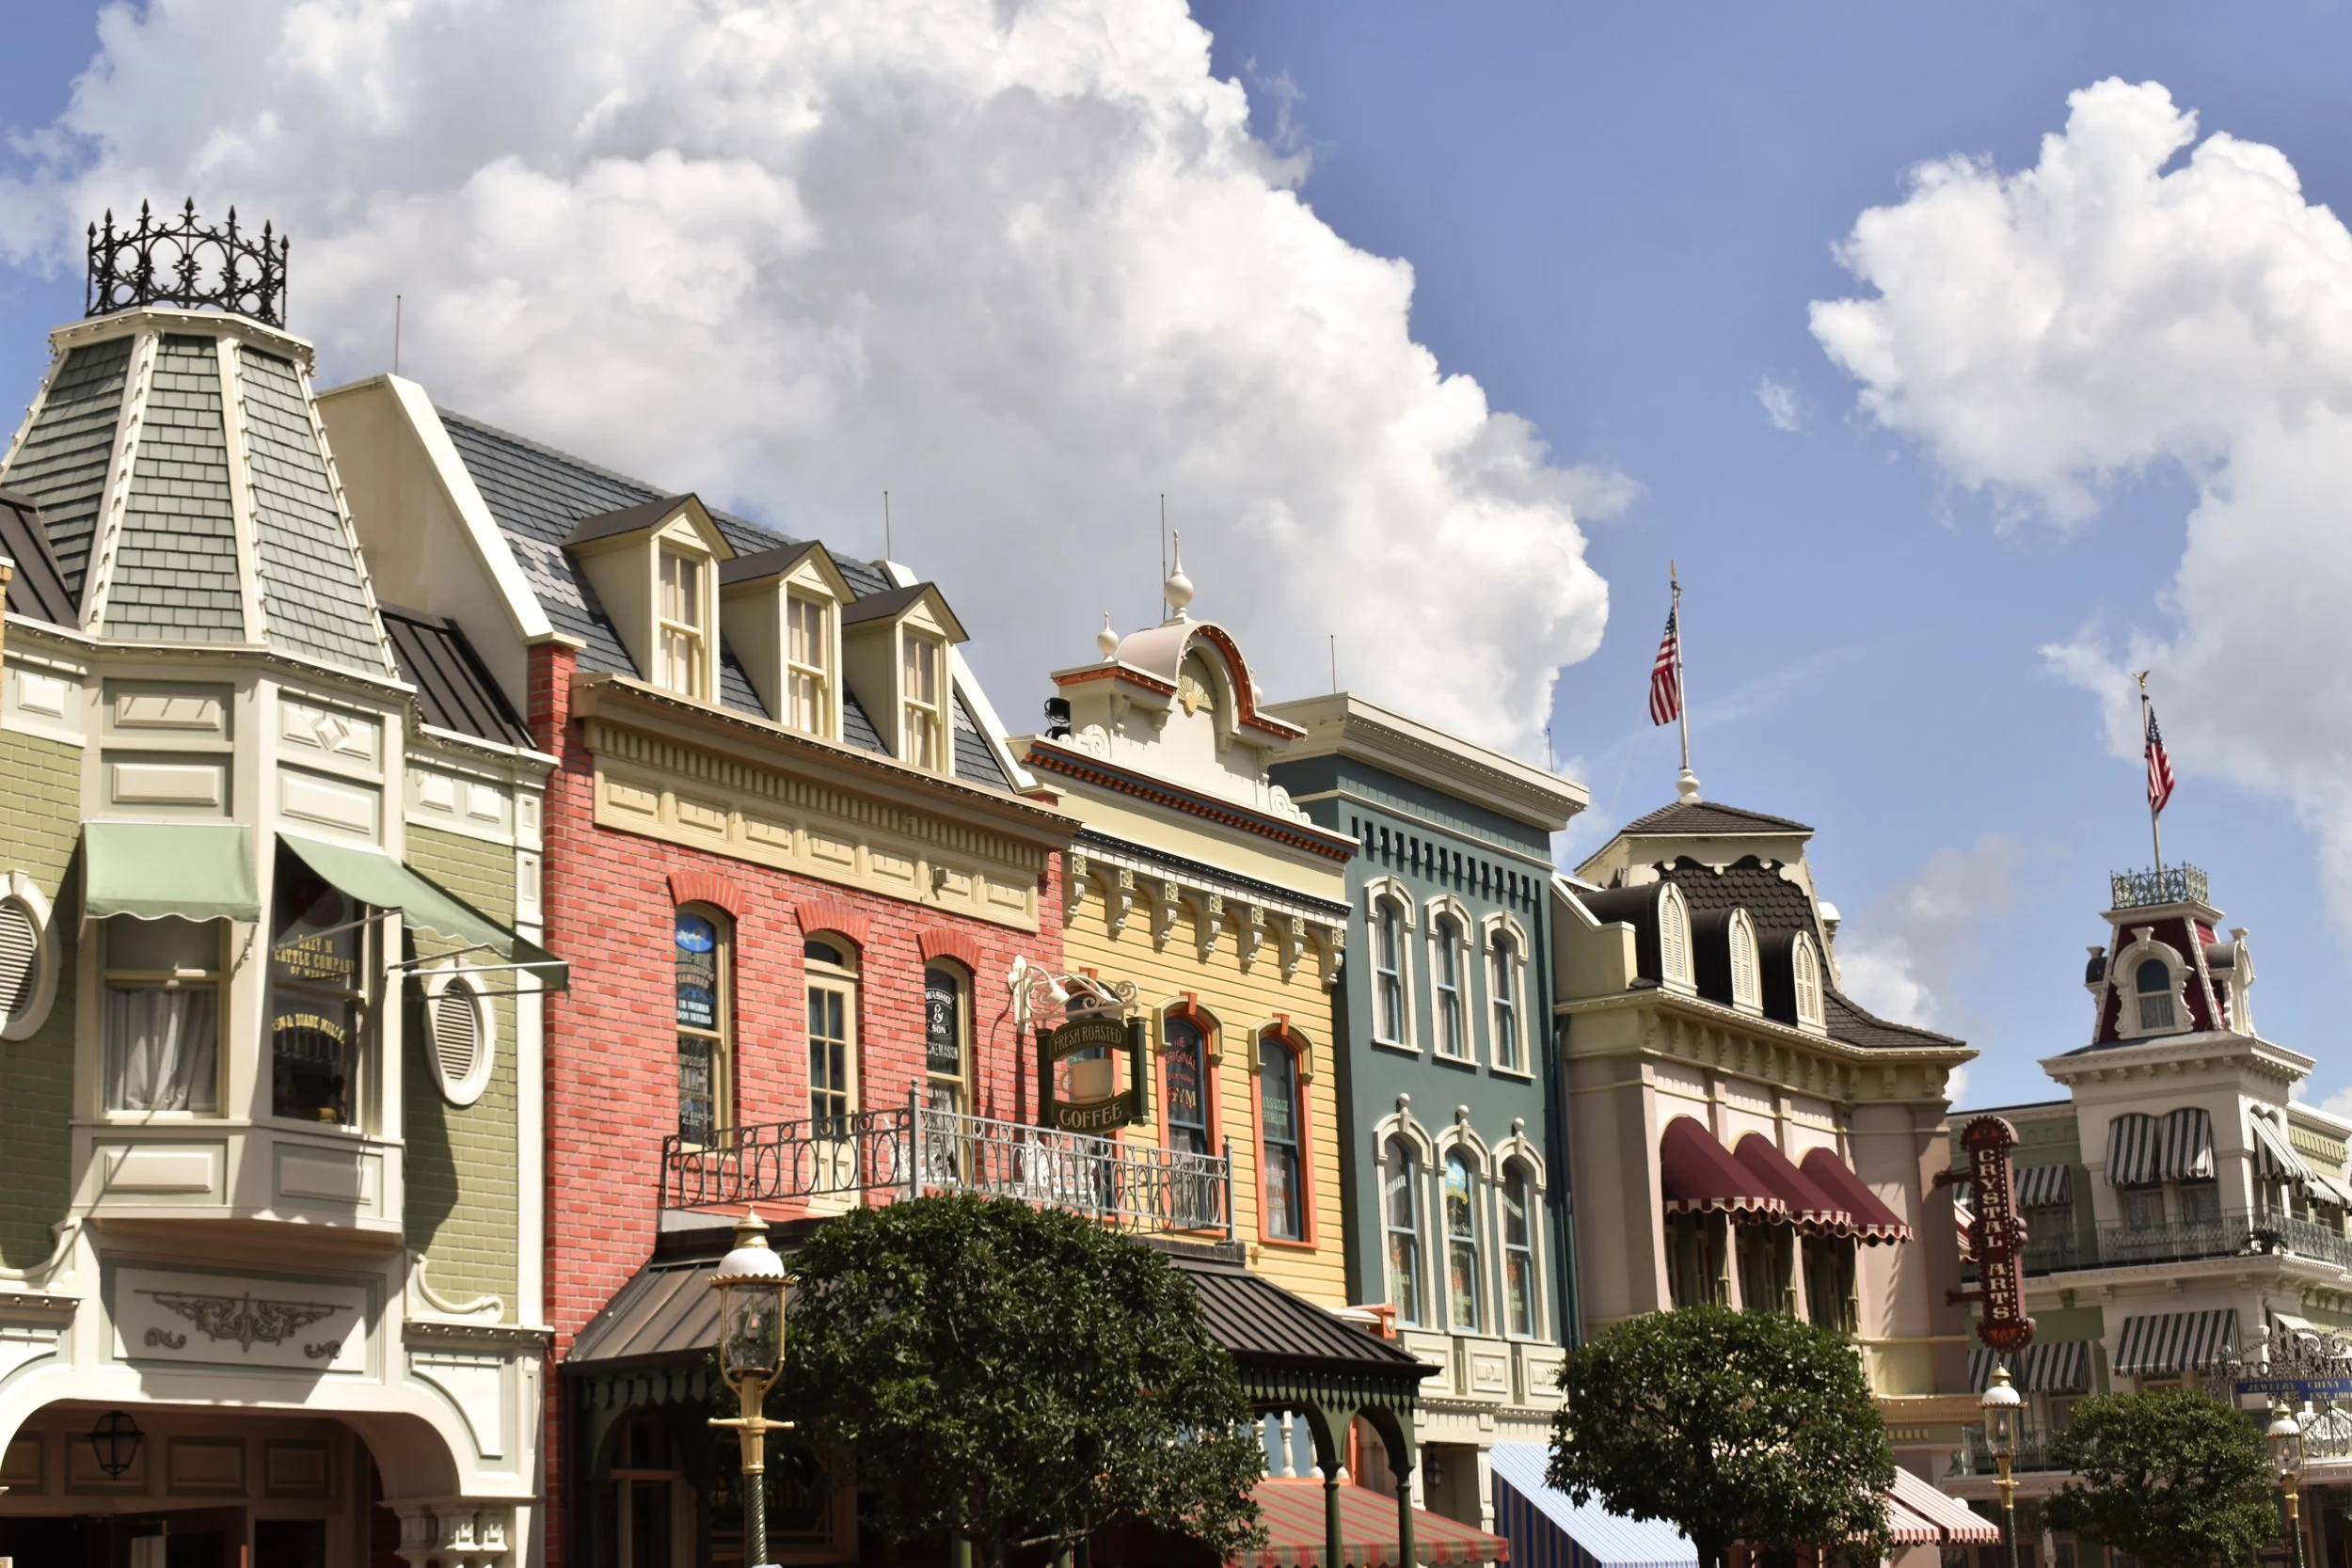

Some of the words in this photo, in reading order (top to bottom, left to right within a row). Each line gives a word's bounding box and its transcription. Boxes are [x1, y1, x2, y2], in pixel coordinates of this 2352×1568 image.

[298, 934, 322, 952] LAZY
[275, 948, 310, 967] CATTLE
[313, 953, 356, 974] COMPANY
[925, 990, 951, 1006] WASHO
[933, 1004, 944, 1023] &
[931, 1024, 946, 1034] SON
[1053, 1030, 1081, 1053] FRESH
[1082, 1025, 1122, 1045] ROASTED
[1165, 1050, 1196, 1070] ORIGINAL
[1167, 1086, 1197, 1109] GYM
[1059, 1101, 1122, 1129] COFFEE
[1979, 1148, 2003, 1248] CRYSTAL
[1989, 1263, 2010, 1321] ARTS
[2247, 1381, 2296, 1393] JEWELRY
[2306, 1380, 2341, 1390] CHINA
[2309, 1391, 2331, 1401] EST.
